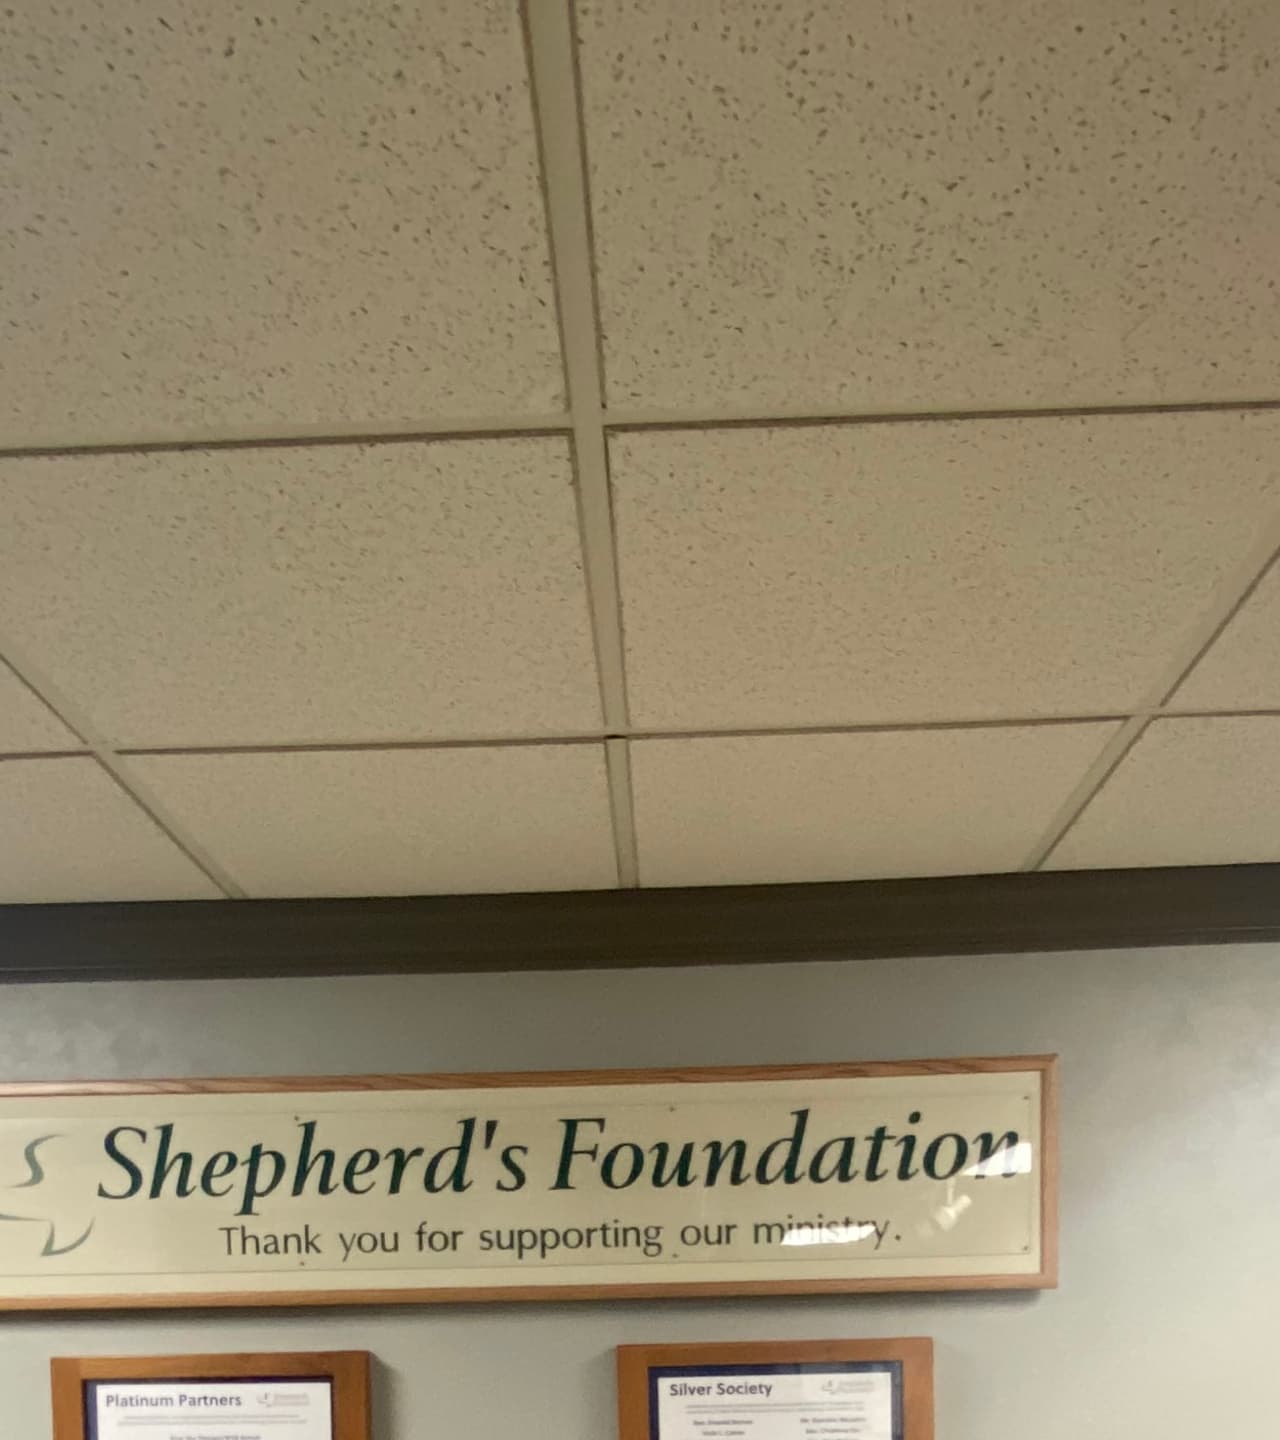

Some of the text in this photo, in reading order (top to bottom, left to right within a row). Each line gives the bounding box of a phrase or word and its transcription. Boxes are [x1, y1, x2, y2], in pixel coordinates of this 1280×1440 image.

[97, 1108, 1020, 1217] Shepherd's Foundation
[219, 1223, 322, 1257] Thank
[338, 1230, 399, 1262] you
[416, 1220, 464, 1253] for
[479, 1218, 663, 1260] supporting
[679, 1221, 738, 1247] our
[106, 1394, 174, 1408] Platinum
[178, 1393, 242, 1407] Partners
[670, 1382, 773, 1397] Silver Society
